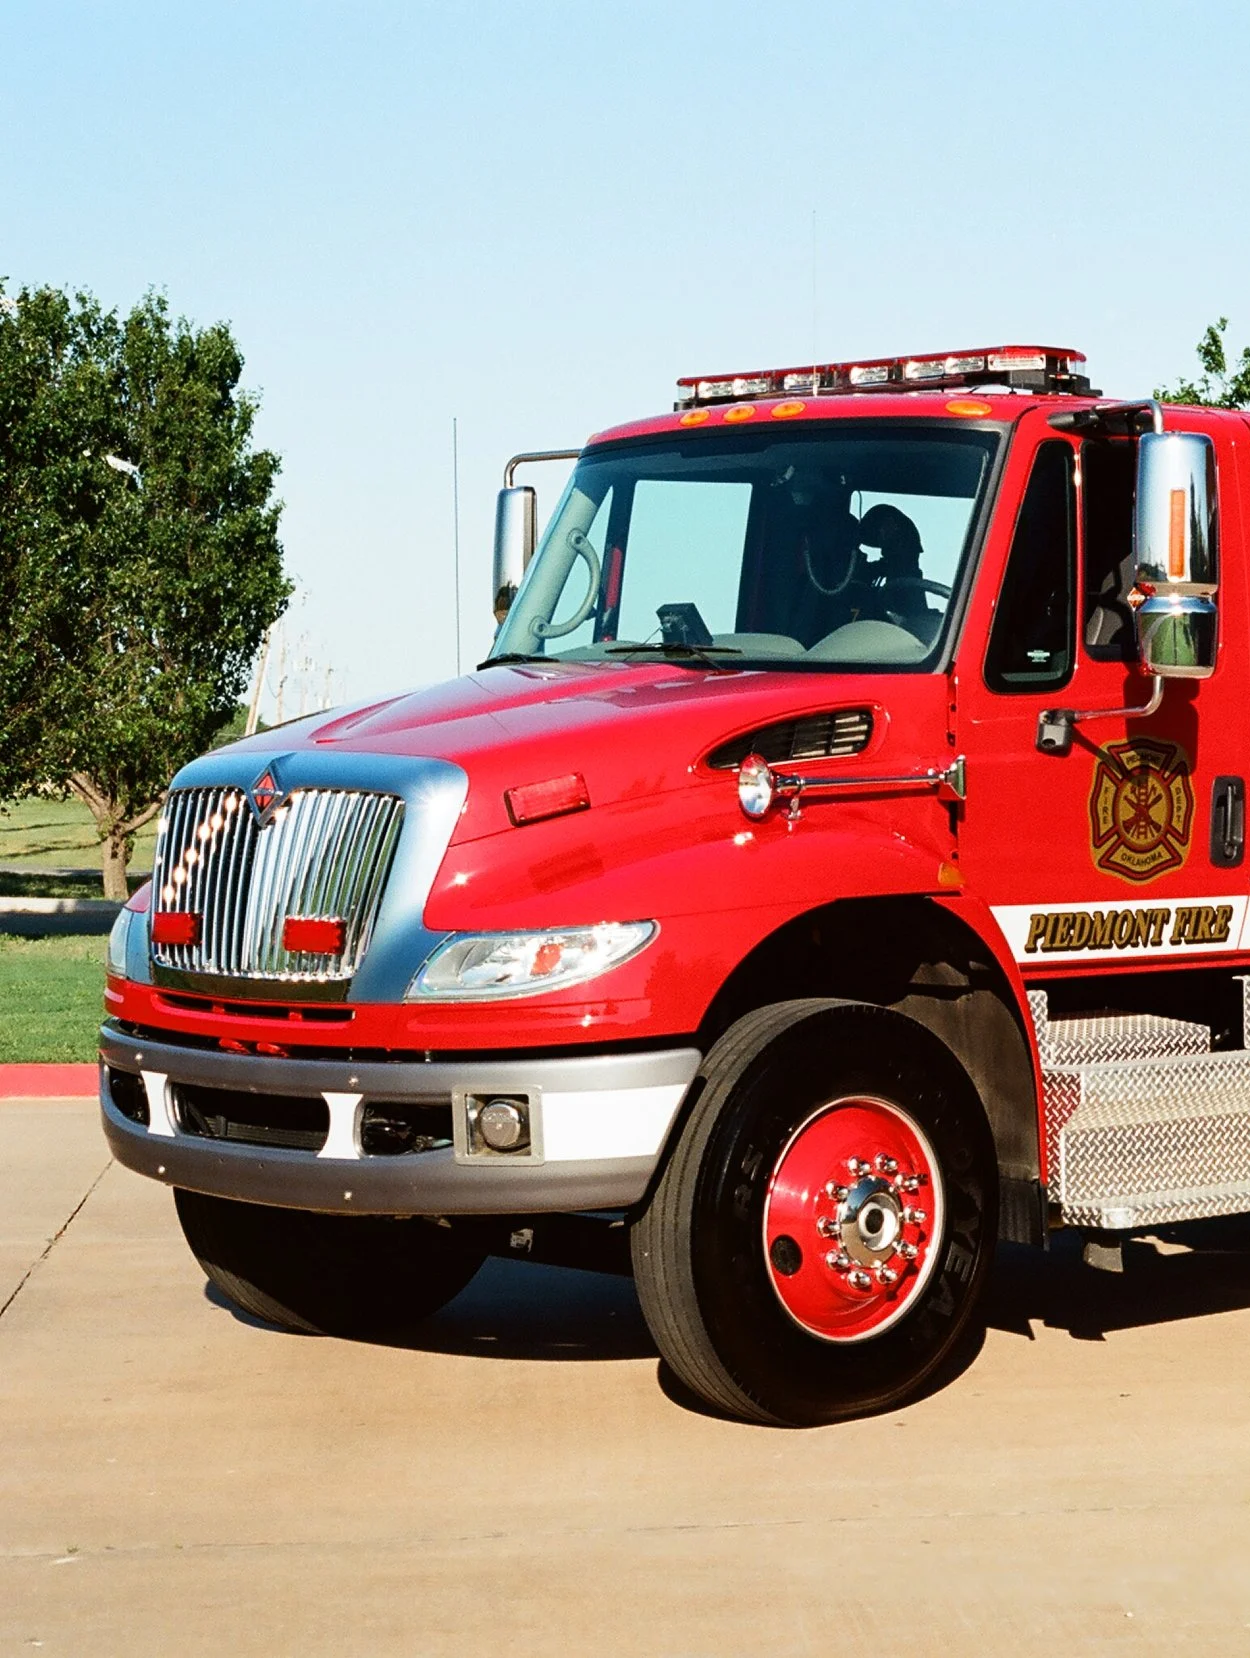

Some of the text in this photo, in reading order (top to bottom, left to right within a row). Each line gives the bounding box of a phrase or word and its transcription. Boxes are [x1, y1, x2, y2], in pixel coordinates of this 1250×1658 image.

[1102, 786, 1111, 825] FIRE
[1121, 852, 1163, 866] OKLAHOMA
[1025, 905, 1233, 953] PIEDMONT FIRE
